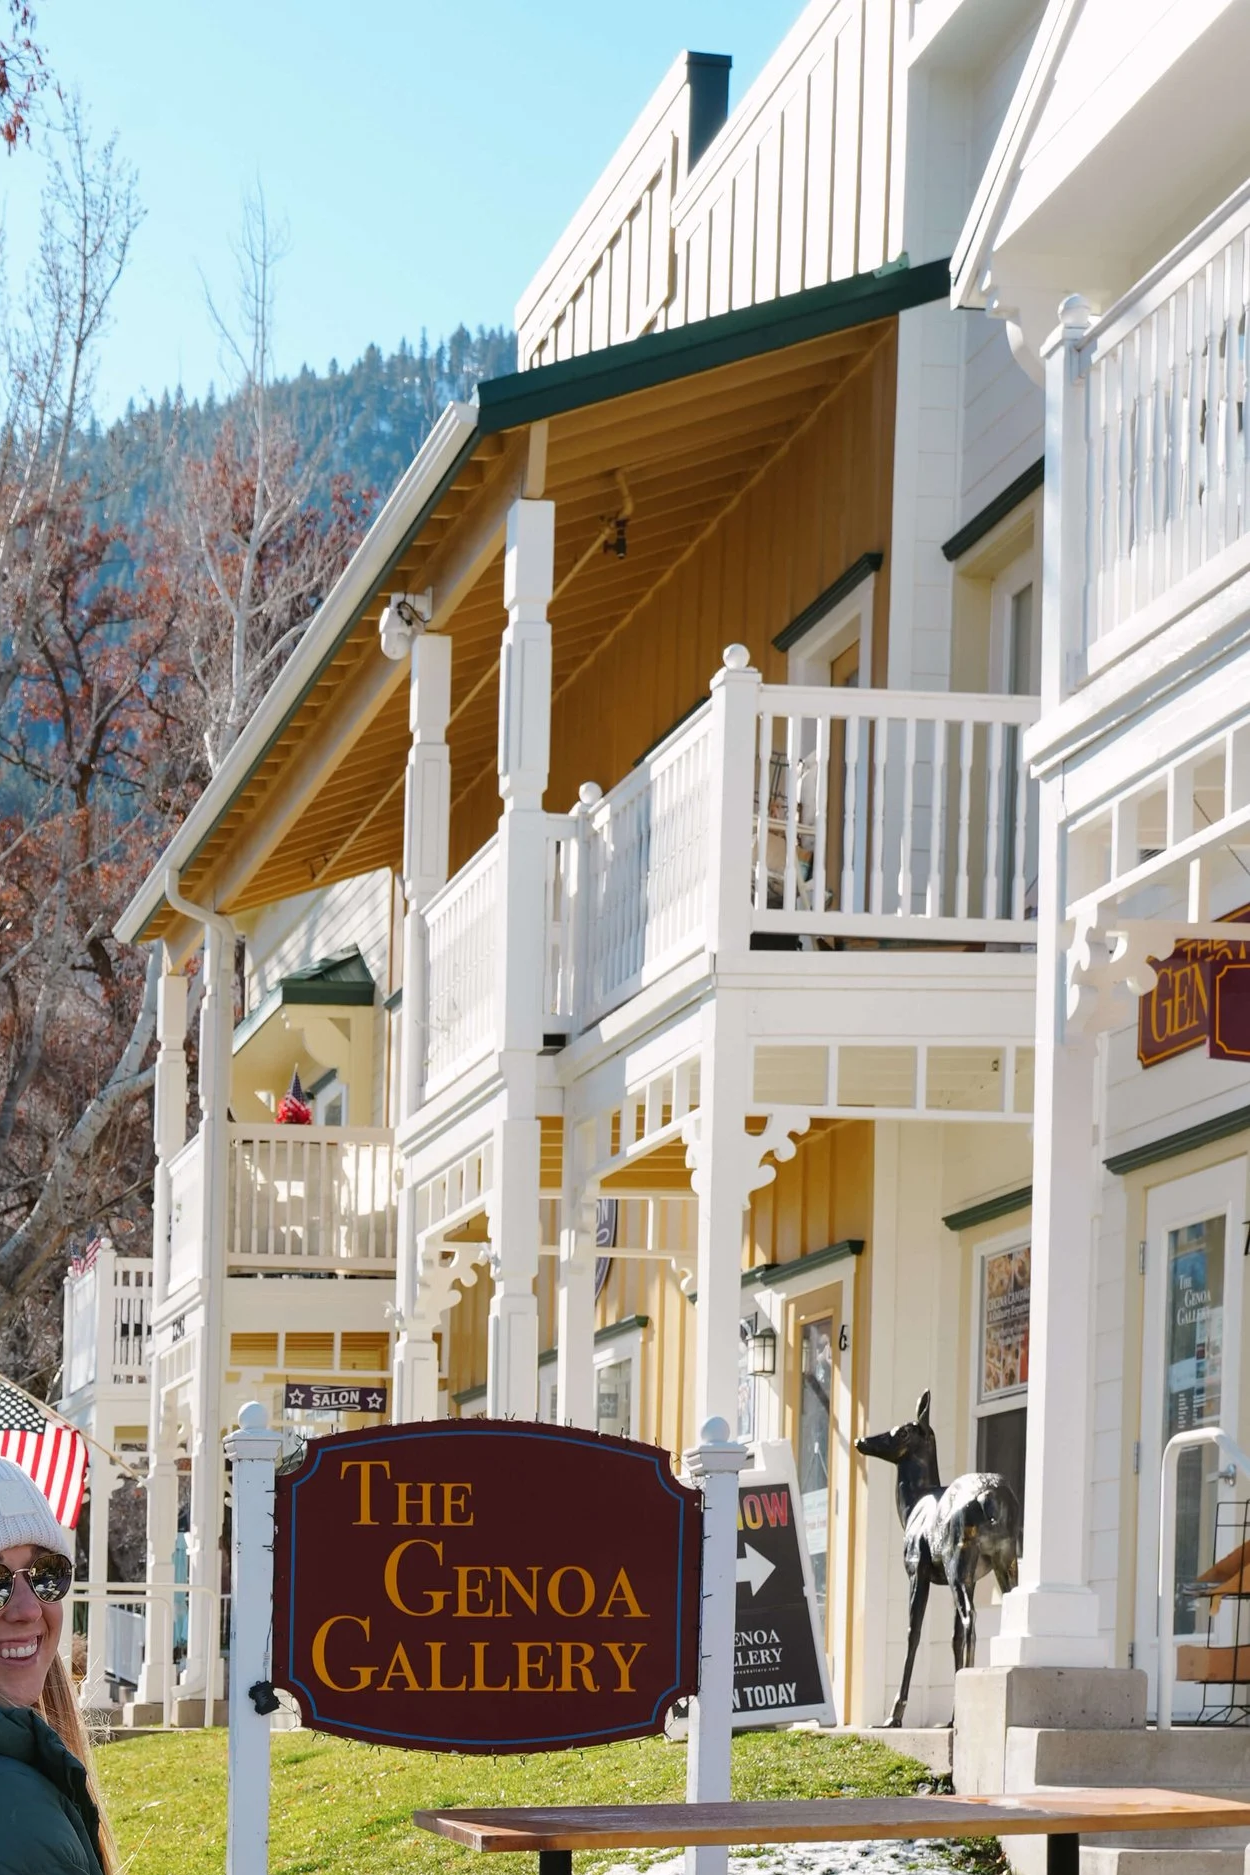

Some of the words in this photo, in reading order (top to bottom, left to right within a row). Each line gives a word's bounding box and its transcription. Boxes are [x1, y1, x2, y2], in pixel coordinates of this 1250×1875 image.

[1185, 1289, 1211, 1308] GENOA
[1177, 1305, 1210, 1326] GALLERY
[311, 1391, 360, 1406] SALON
[340, 1460, 474, 1526] THE
[384, 1539, 650, 1618] GENOA
[734, 1629, 781, 1647] ENOA
[311, 1615, 648, 1693] GALLERY
[743, 1682, 797, 1708] TODAY
